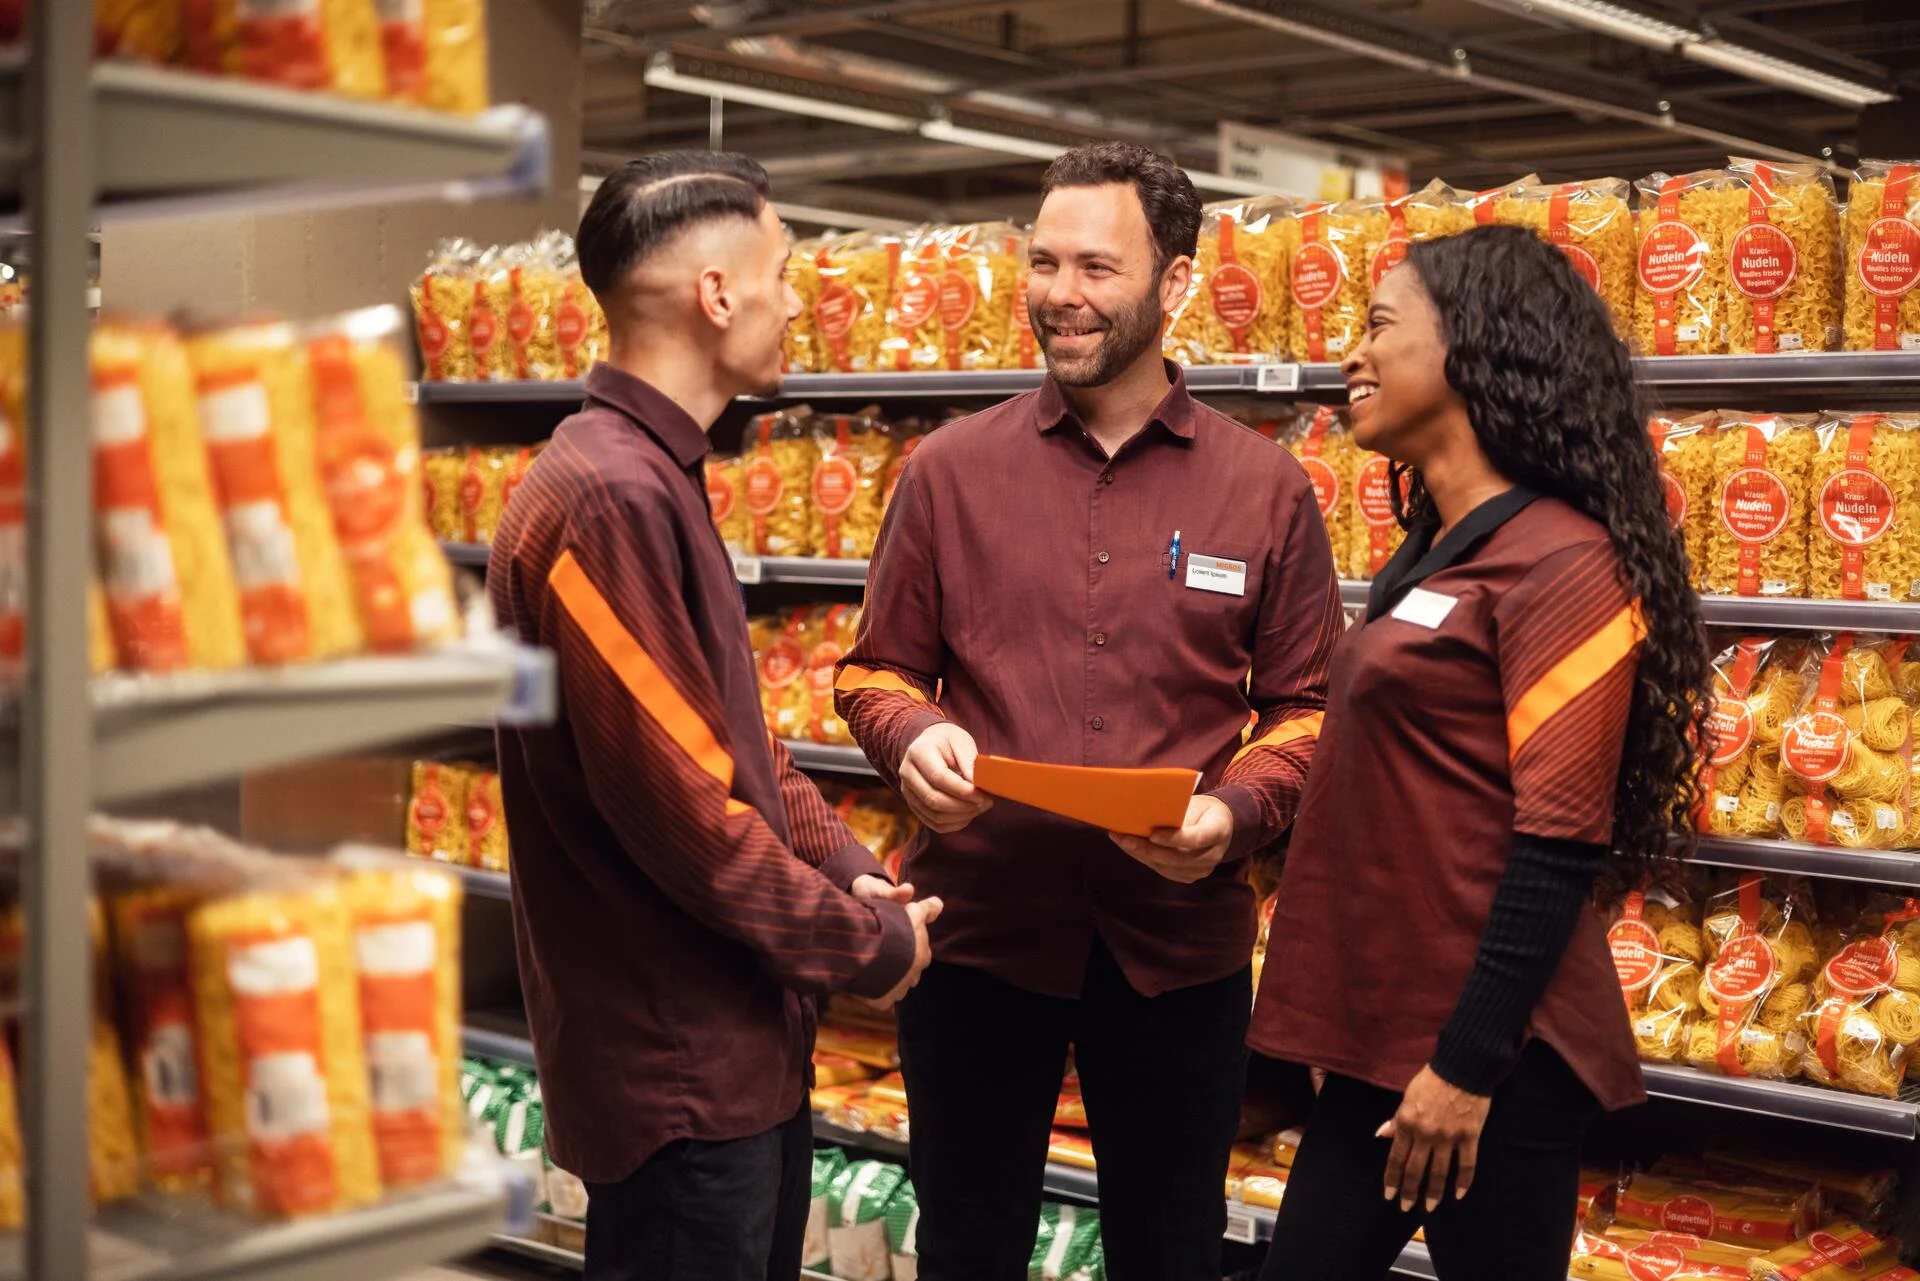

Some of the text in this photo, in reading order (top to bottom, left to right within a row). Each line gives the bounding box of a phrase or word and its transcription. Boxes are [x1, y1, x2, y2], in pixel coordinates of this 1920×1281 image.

[1648, 251, 1685, 265] Nudeln
[1742, 256, 1779, 269] Nudeln
[1871, 251, 1910, 264] Nudeln
[1735, 498, 1772, 513] Nudeln
[1835, 501, 1877, 514] Nudeln
[1666, 1211, 1710, 1226] Spaghettini
